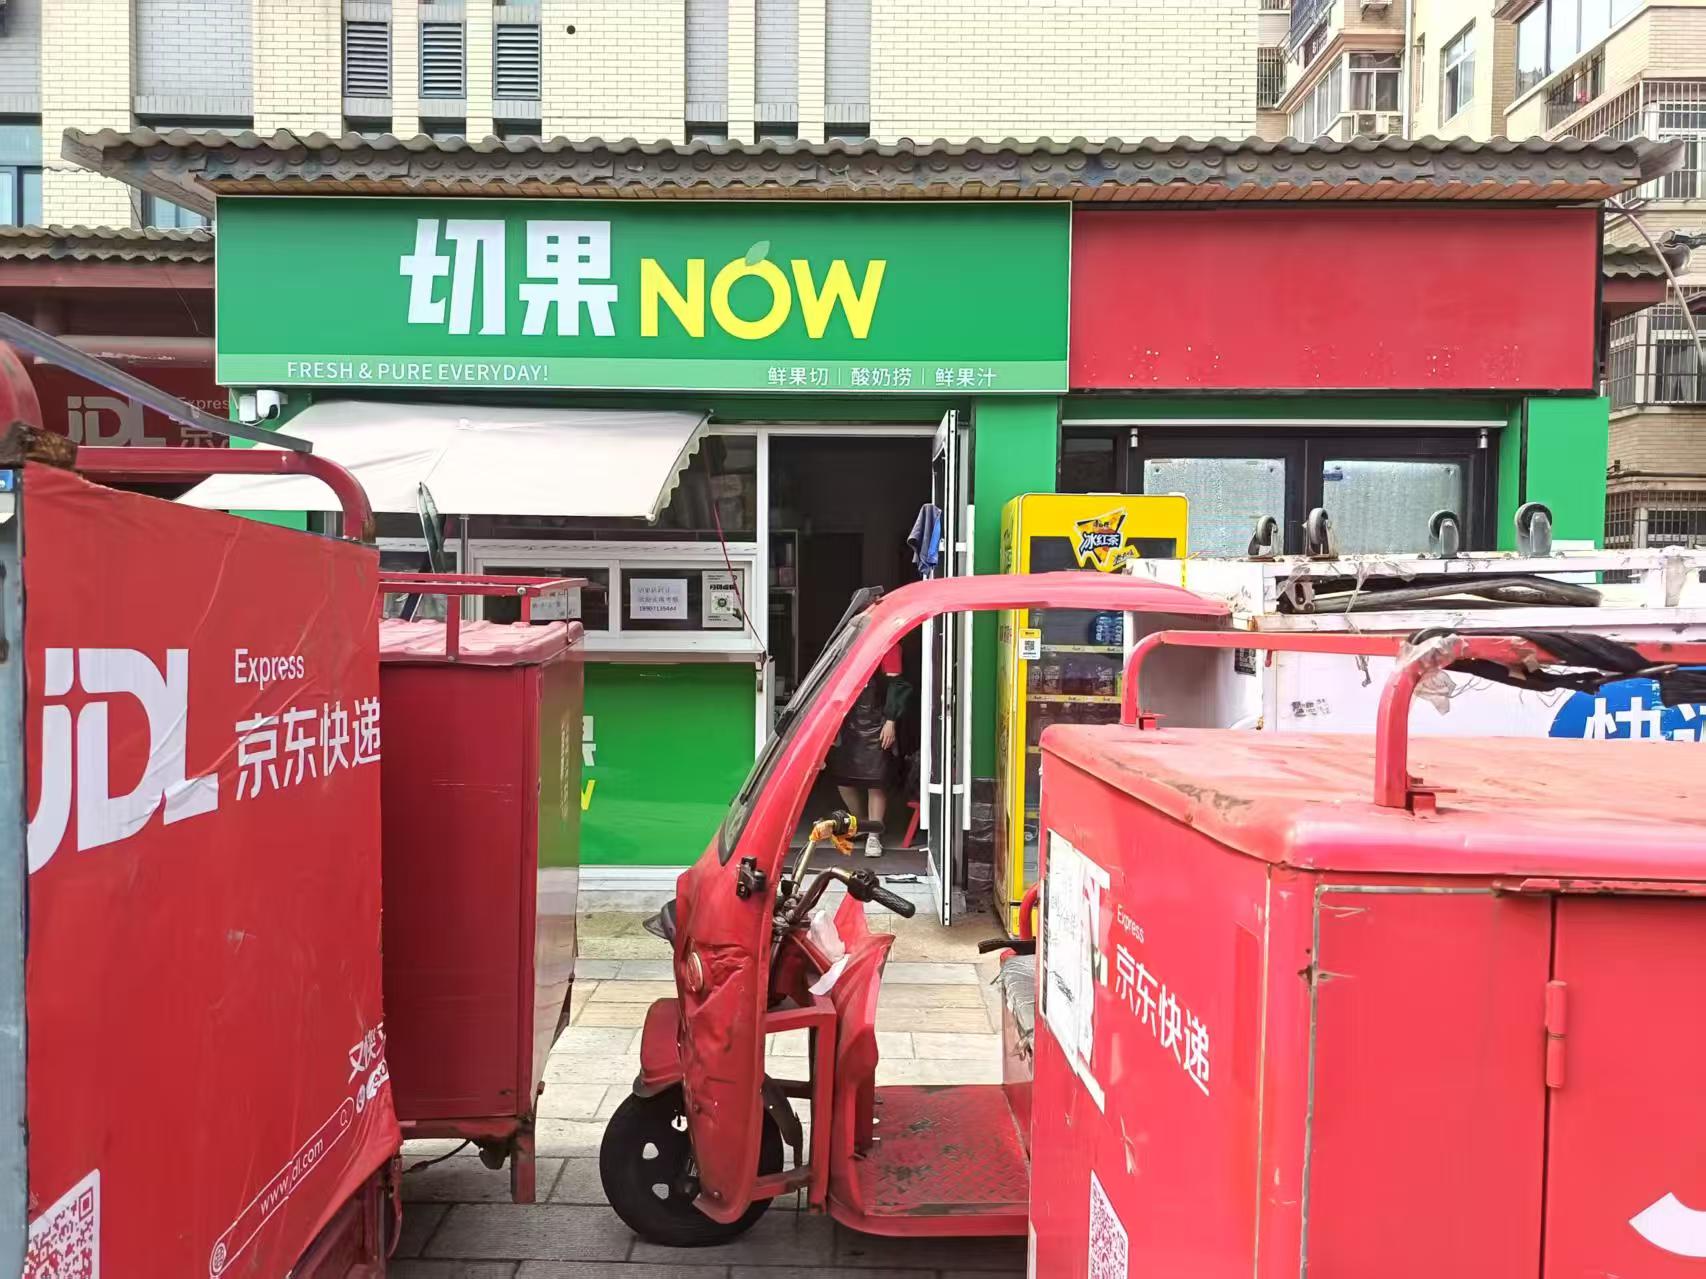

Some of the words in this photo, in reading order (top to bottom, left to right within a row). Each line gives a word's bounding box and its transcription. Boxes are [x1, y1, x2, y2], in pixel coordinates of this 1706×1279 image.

[400, 218, 618, 337] 切果
[640, 257, 887, 340] NOW
[287, 361, 353, 379] FRESH
[358, 362, 373, 379] &
[378, 363, 433, 380] PURE
[439, 363, 549, 381] EVERYDAY!
[767, 367, 830, 386] 鲜果切
[850, 367, 913, 387] 酸奶捞
[935, 367, 998, 387] 鲜果汁
[234, 648, 305, 689] Express
[27, 648, 219, 874] JDL
[235, 696, 382, 800] 京东快递
[1116, 904, 1145, 944] Express
[1116, 944, 1209, 1096] 京东快递
